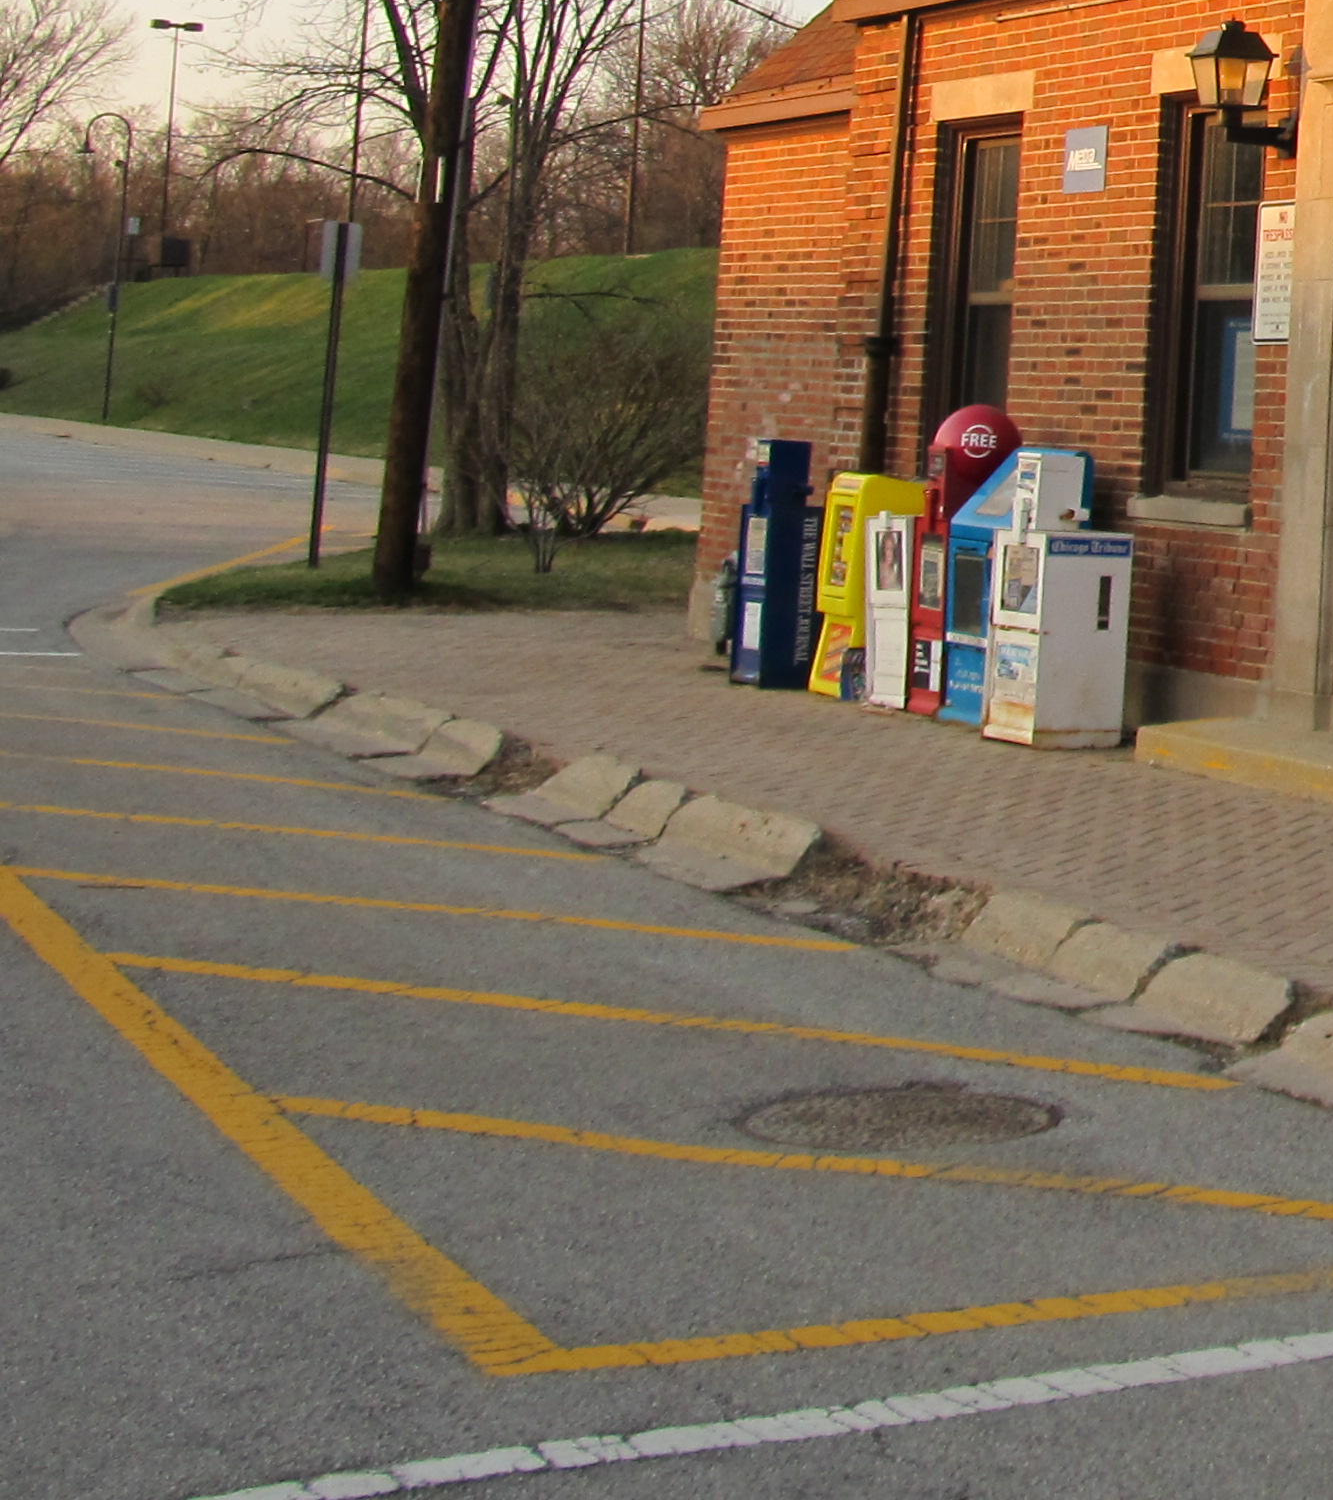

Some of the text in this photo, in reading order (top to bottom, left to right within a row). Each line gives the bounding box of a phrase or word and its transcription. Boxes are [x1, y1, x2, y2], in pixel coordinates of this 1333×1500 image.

[960, 432, 998, 448] FREE
[1051, 540, 1128, 555] Chicago Tribune
[793, 516, 818, 666] THE WALL STREET JOURNAL
